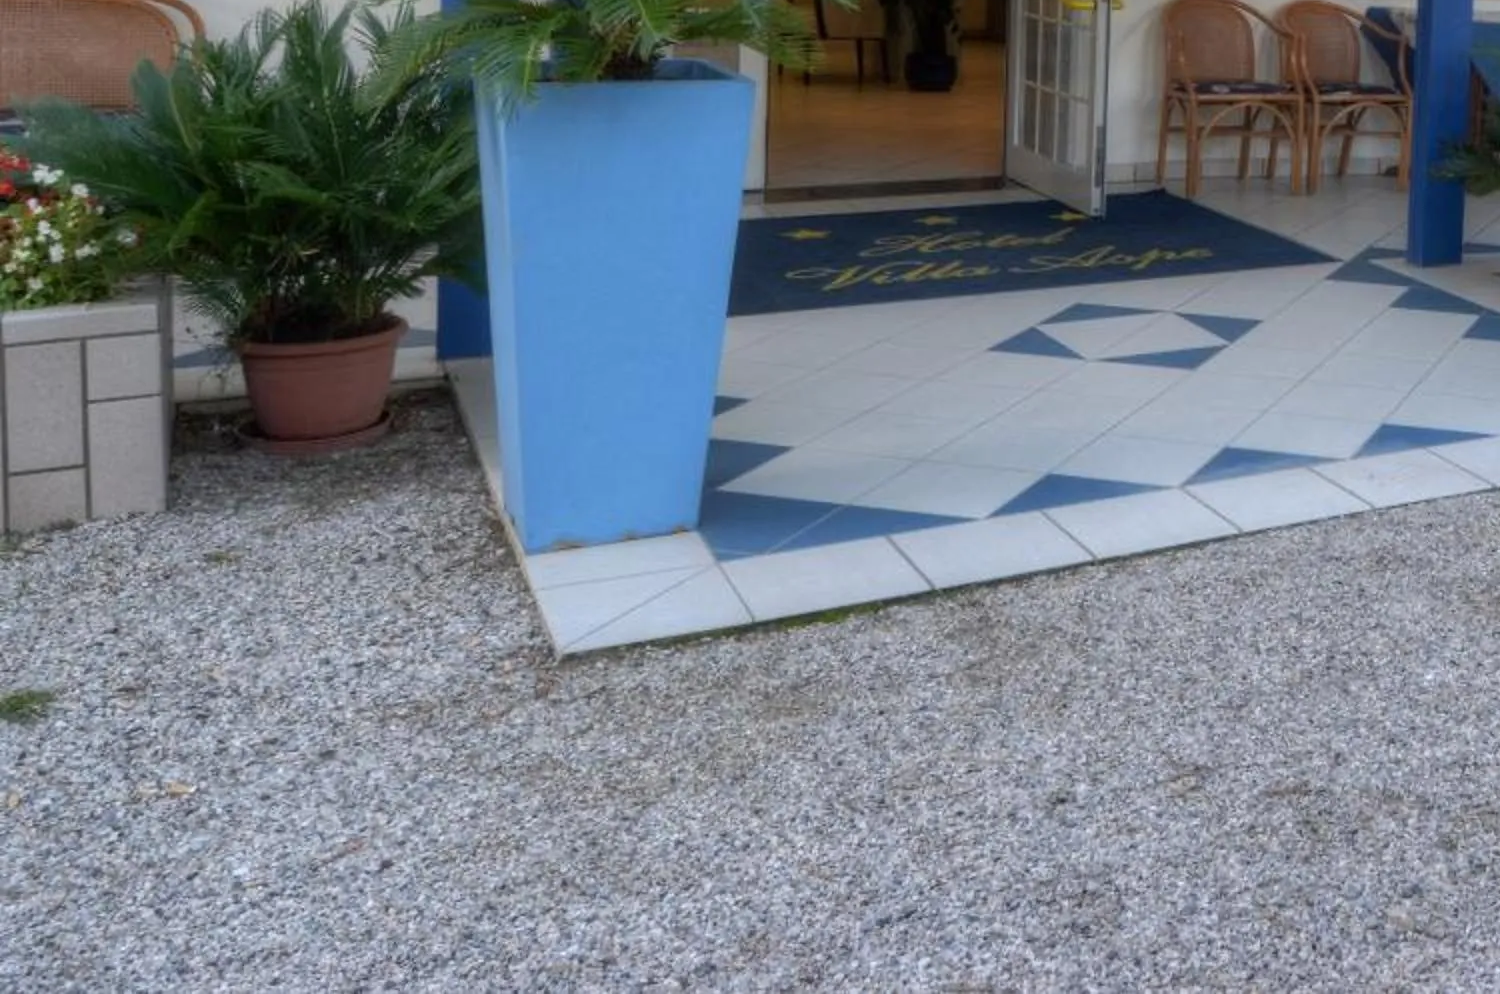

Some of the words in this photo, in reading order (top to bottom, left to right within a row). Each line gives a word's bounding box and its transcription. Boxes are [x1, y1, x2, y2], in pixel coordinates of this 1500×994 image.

[858, 227, 1075, 257] Hotel
[785, 260, 998, 292] Villa
[1008, 244, 1213, 271] Aspe
